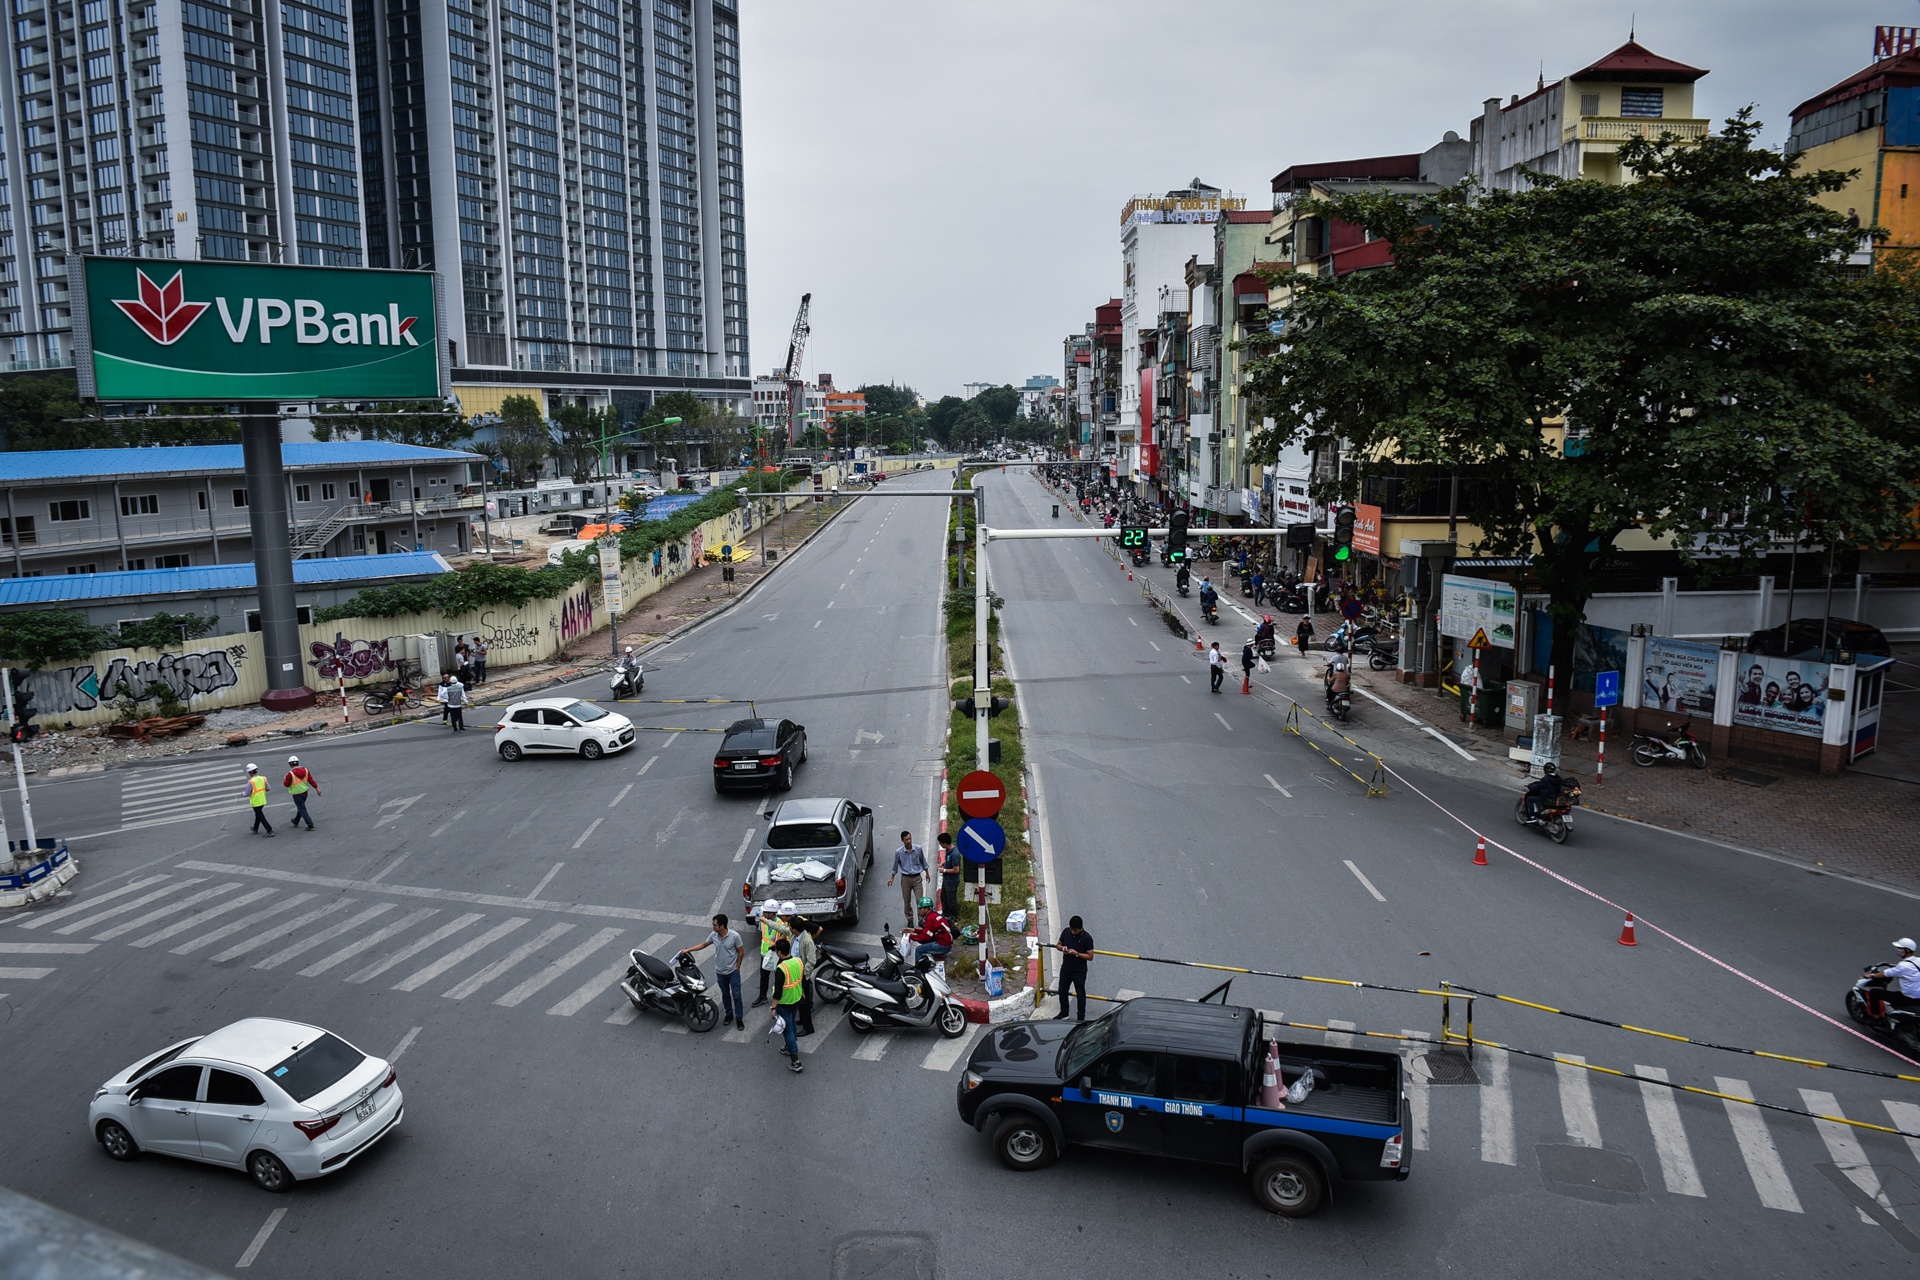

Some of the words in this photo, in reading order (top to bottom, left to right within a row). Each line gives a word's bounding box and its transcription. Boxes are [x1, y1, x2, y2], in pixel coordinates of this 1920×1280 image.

[1166, 212, 1201, 222] KHOA
[215, 297, 419, 346] VPBank
[1124, 530, 1144, 546] 22
[561, 588, 593, 641] ARMA
[1099, 1093, 1119, 1106] THANH
[1120, 1096, 1132, 1108] TRA
[1165, 1102, 1180, 1114] GIAO
[1182, 1102, 1203, 1116] THÔNG
